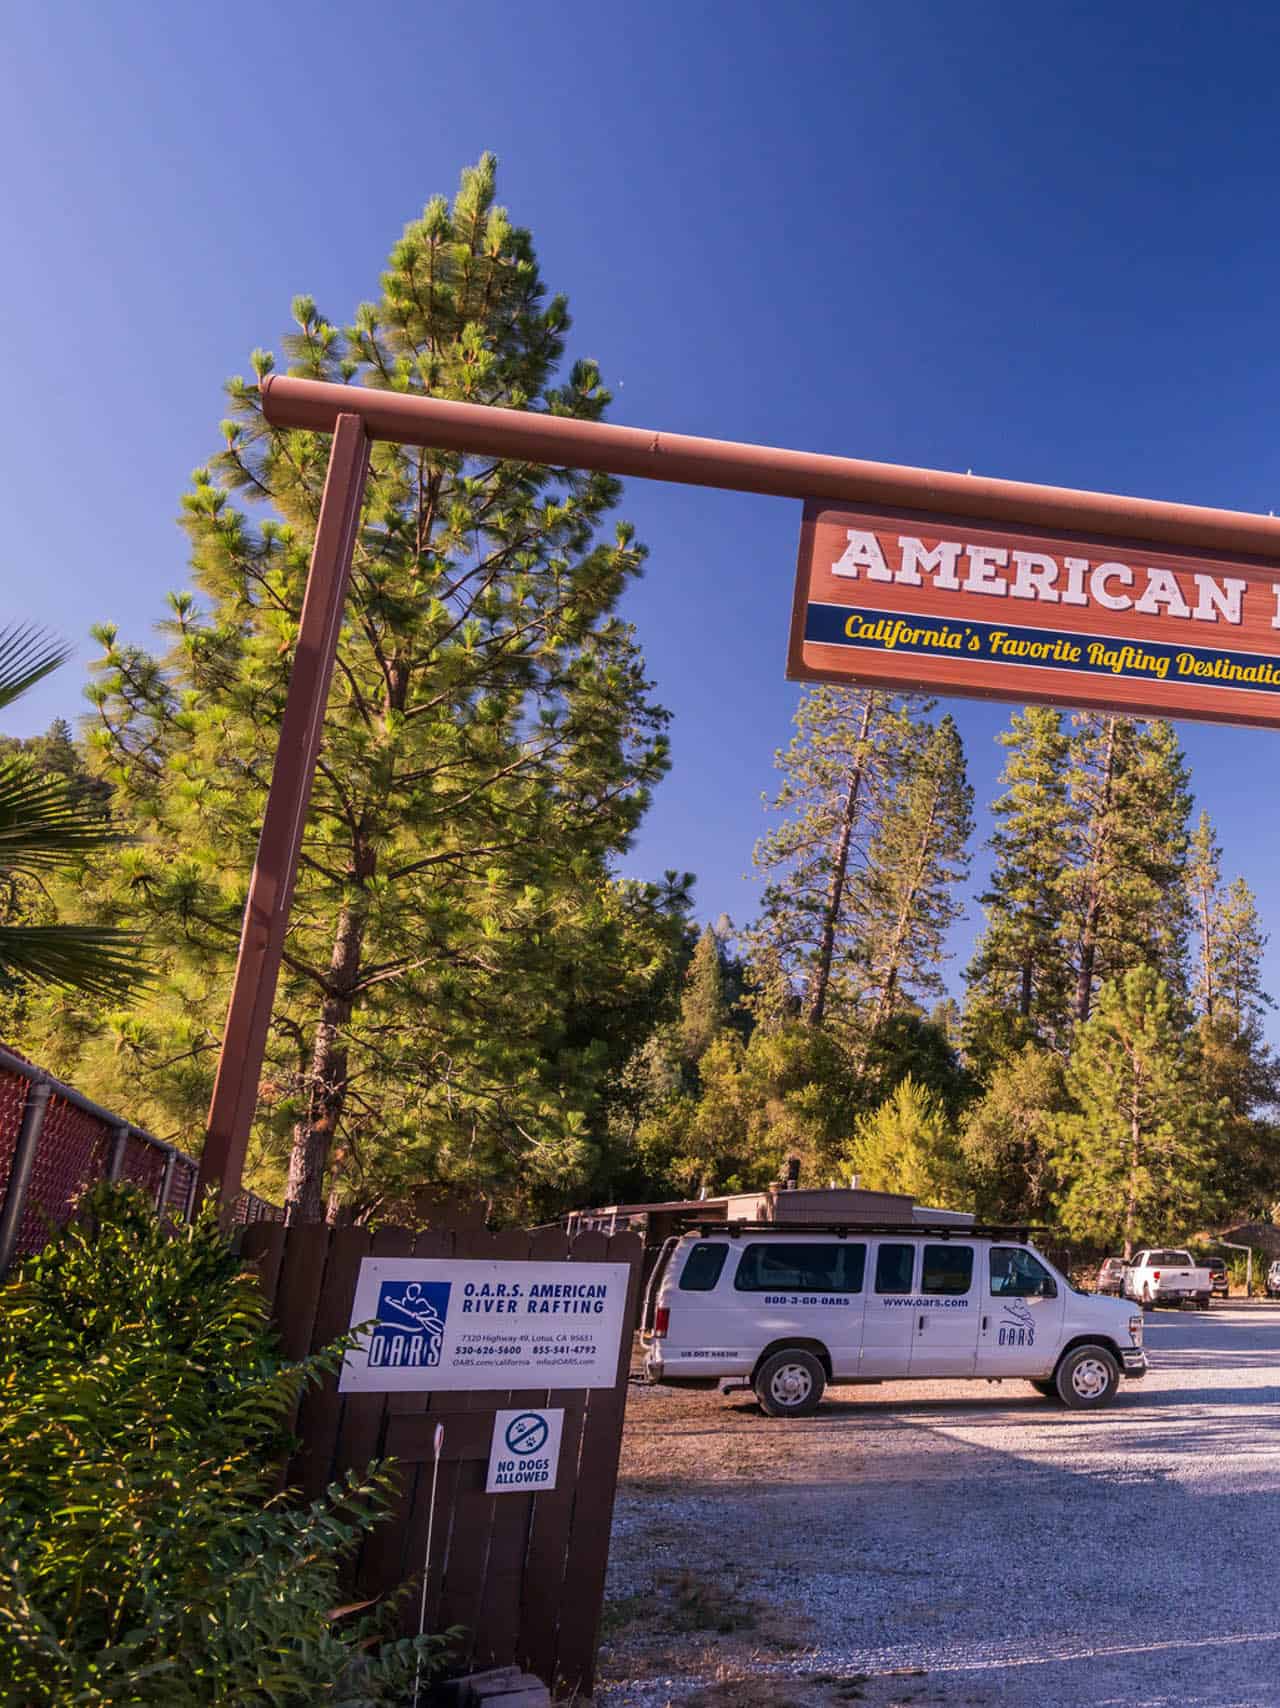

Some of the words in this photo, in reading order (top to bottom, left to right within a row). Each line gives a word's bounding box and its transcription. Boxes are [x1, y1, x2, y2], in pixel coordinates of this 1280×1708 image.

[831, 529, 1247, 625] AMERICAN
[844, 615, 981, 650] California's
[988, 631, 1082, 664] Favorite
[1087, 642, 1172, 680] Rafting
[464, 1282, 524, 1297] O.A.R.S.
[529, 1283, 607, 1298] AMERICAN
[462, 1299, 518, 1313] RIVER
[527, 1300, 604, 1314] RAFTING
[883, 1298, 968, 1307] www.oars.com
[482, 1334, 517, 1343] Highway
[497, 1461, 514, 1472] NO
[519, 1459, 549, 1470] DOGS
[495, 1471, 549, 1484] ALLOWED
